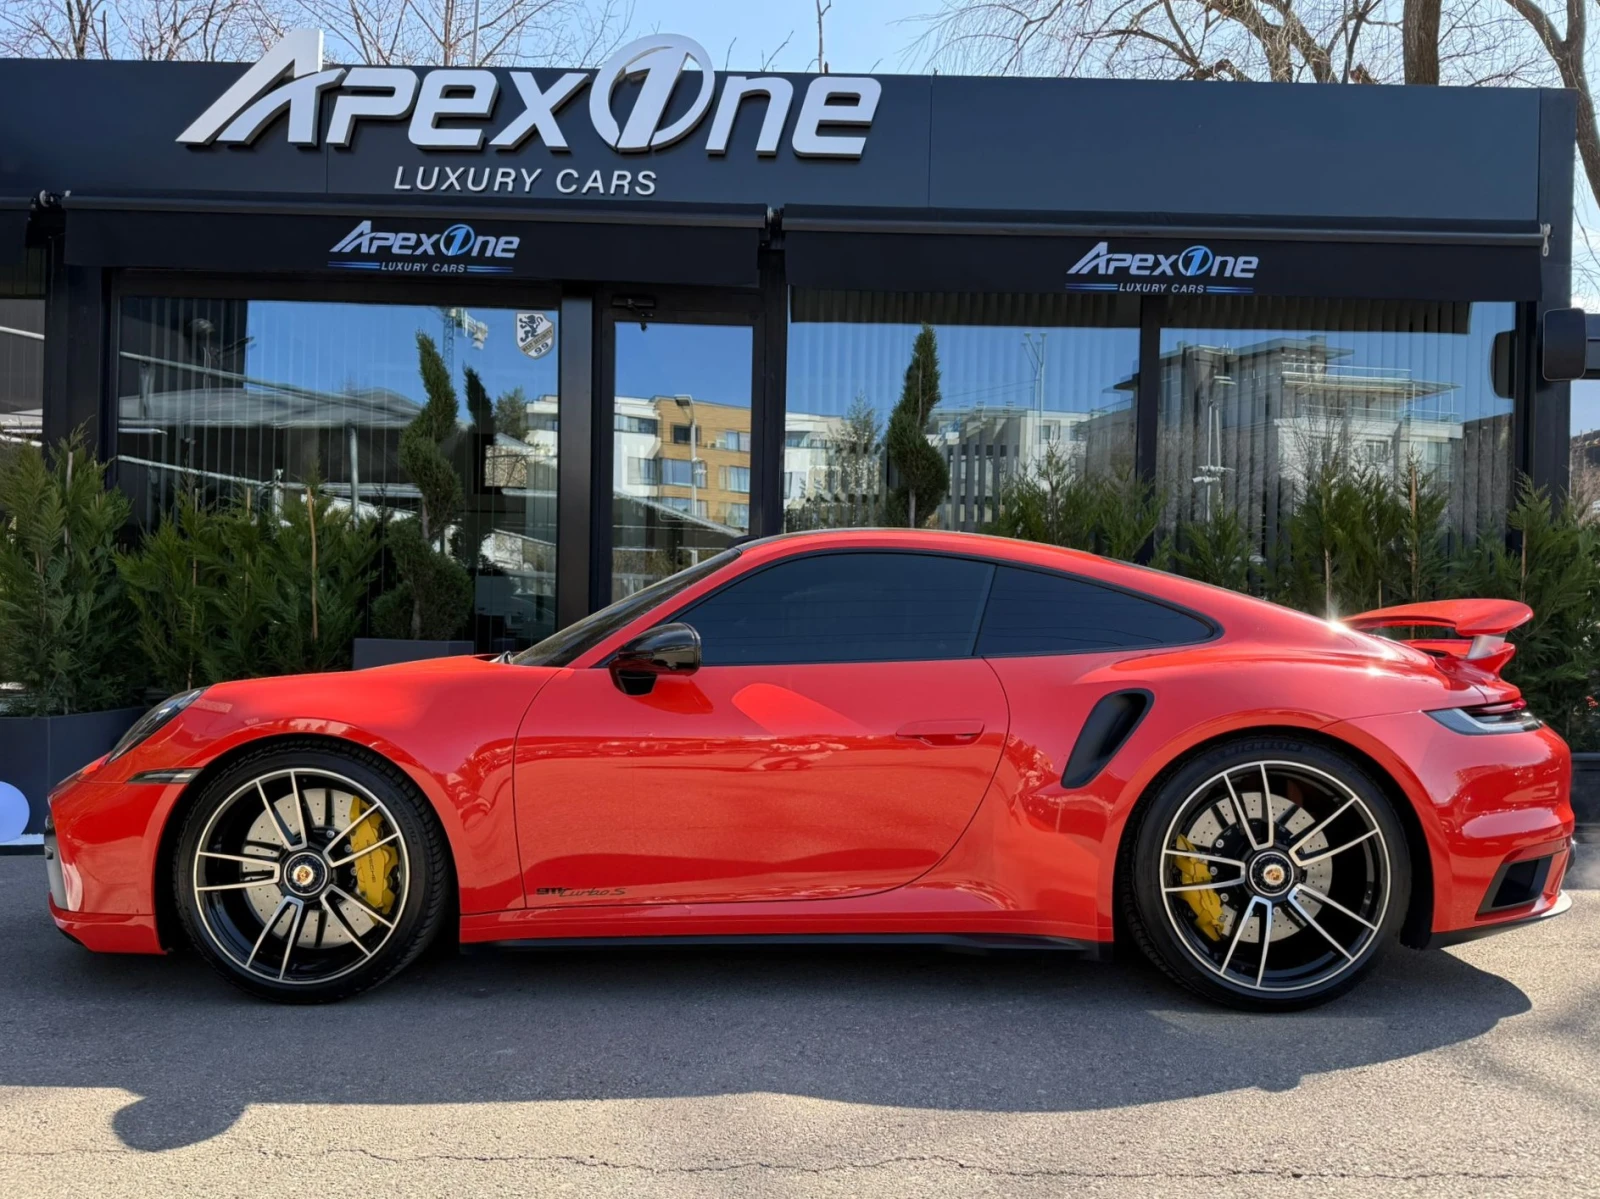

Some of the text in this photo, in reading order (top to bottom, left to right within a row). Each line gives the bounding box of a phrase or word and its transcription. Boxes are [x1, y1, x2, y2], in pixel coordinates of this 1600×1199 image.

[394, 166, 657, 196] LUXURY CARS
[381, 262, 465, 273] LUXURY CARS
[1119, 283, 1204, 294] LUXURY CARS
[534, 342, 549, 355] 99
